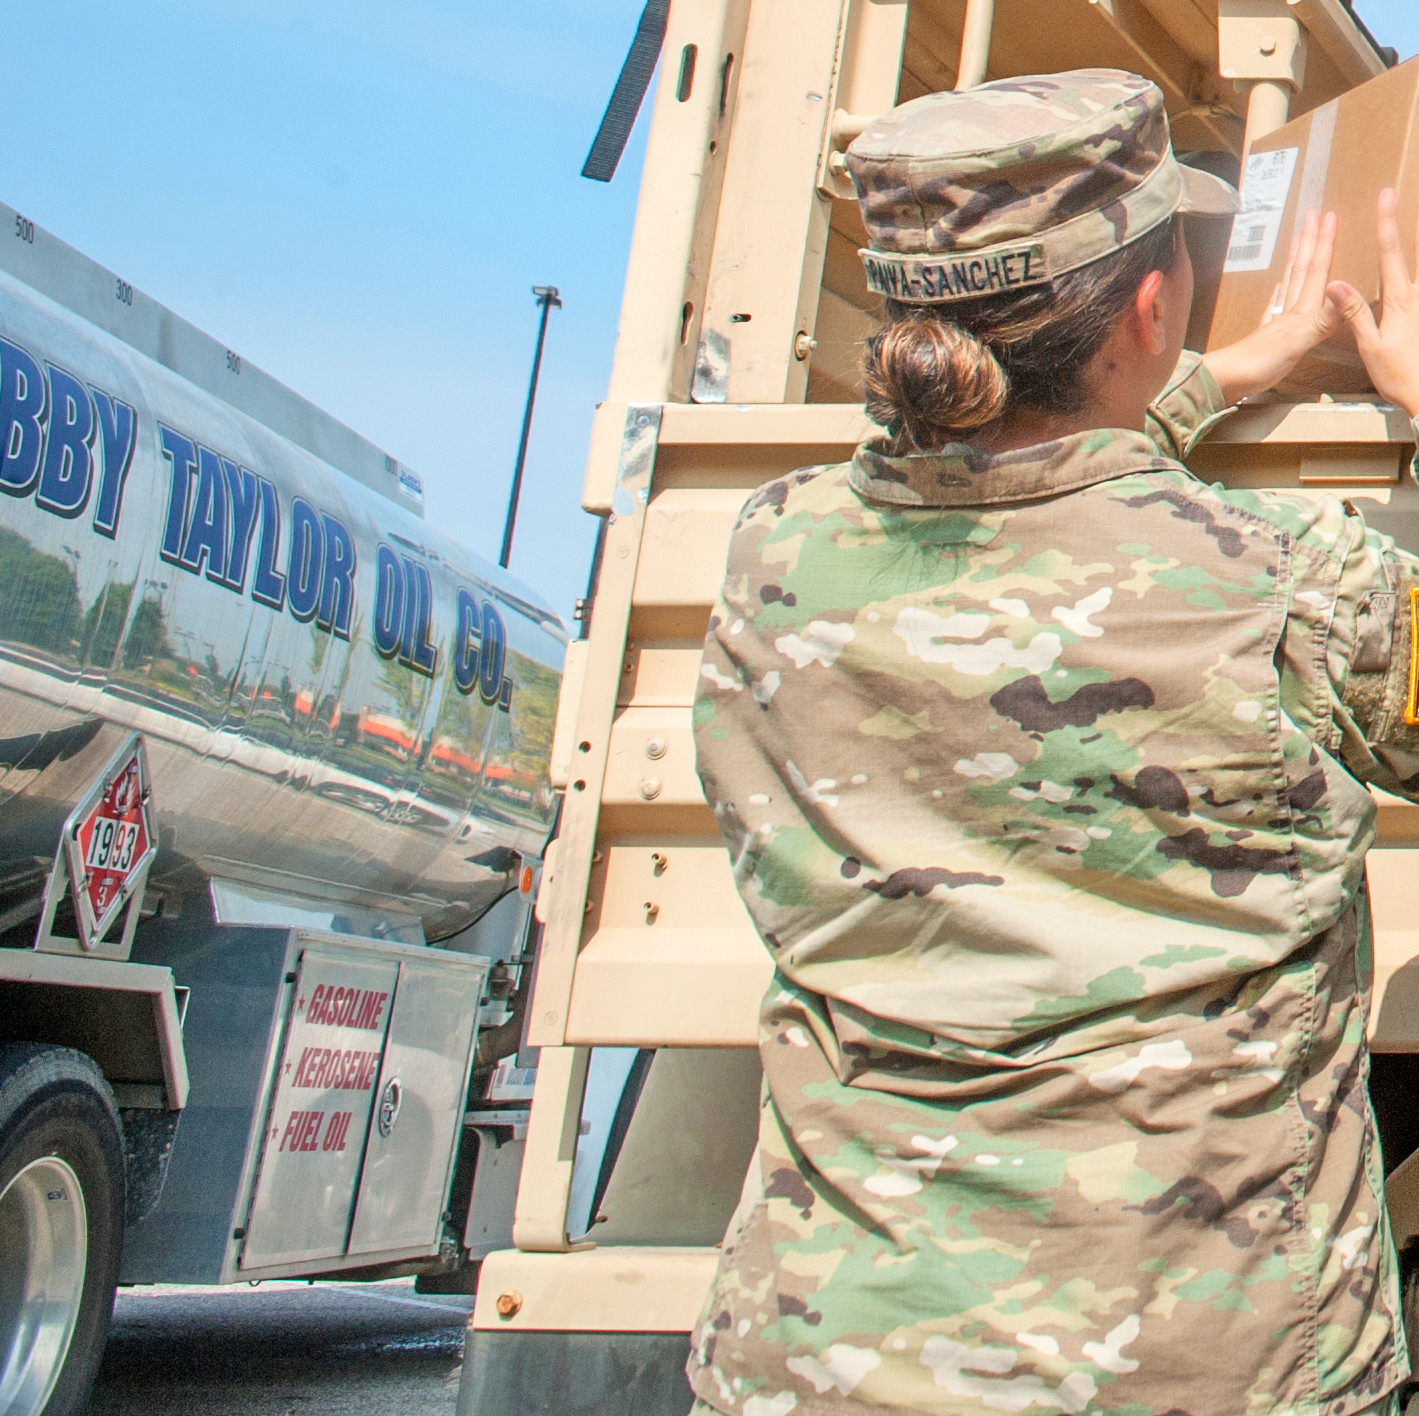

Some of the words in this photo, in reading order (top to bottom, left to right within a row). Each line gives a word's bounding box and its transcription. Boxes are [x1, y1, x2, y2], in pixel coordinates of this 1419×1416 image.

[15, 214, 35, 245] 500
[115, 278, 133, 307] 300
[226, 350, 242, 376] 500
[158, 419, 357, 641] TAYLOR
[373, 540, 437, 678] OIL
[454, 584, 513, 712] CO.
[89, 819, 136, 872] 1993
[305, 984, 388, 1030] GASOLINE
[291, 1046, 381, 1091] KEROSENE
[278, 1110, 325, 1153] FUEL
[322, 1111, 353, 1152] OIL
